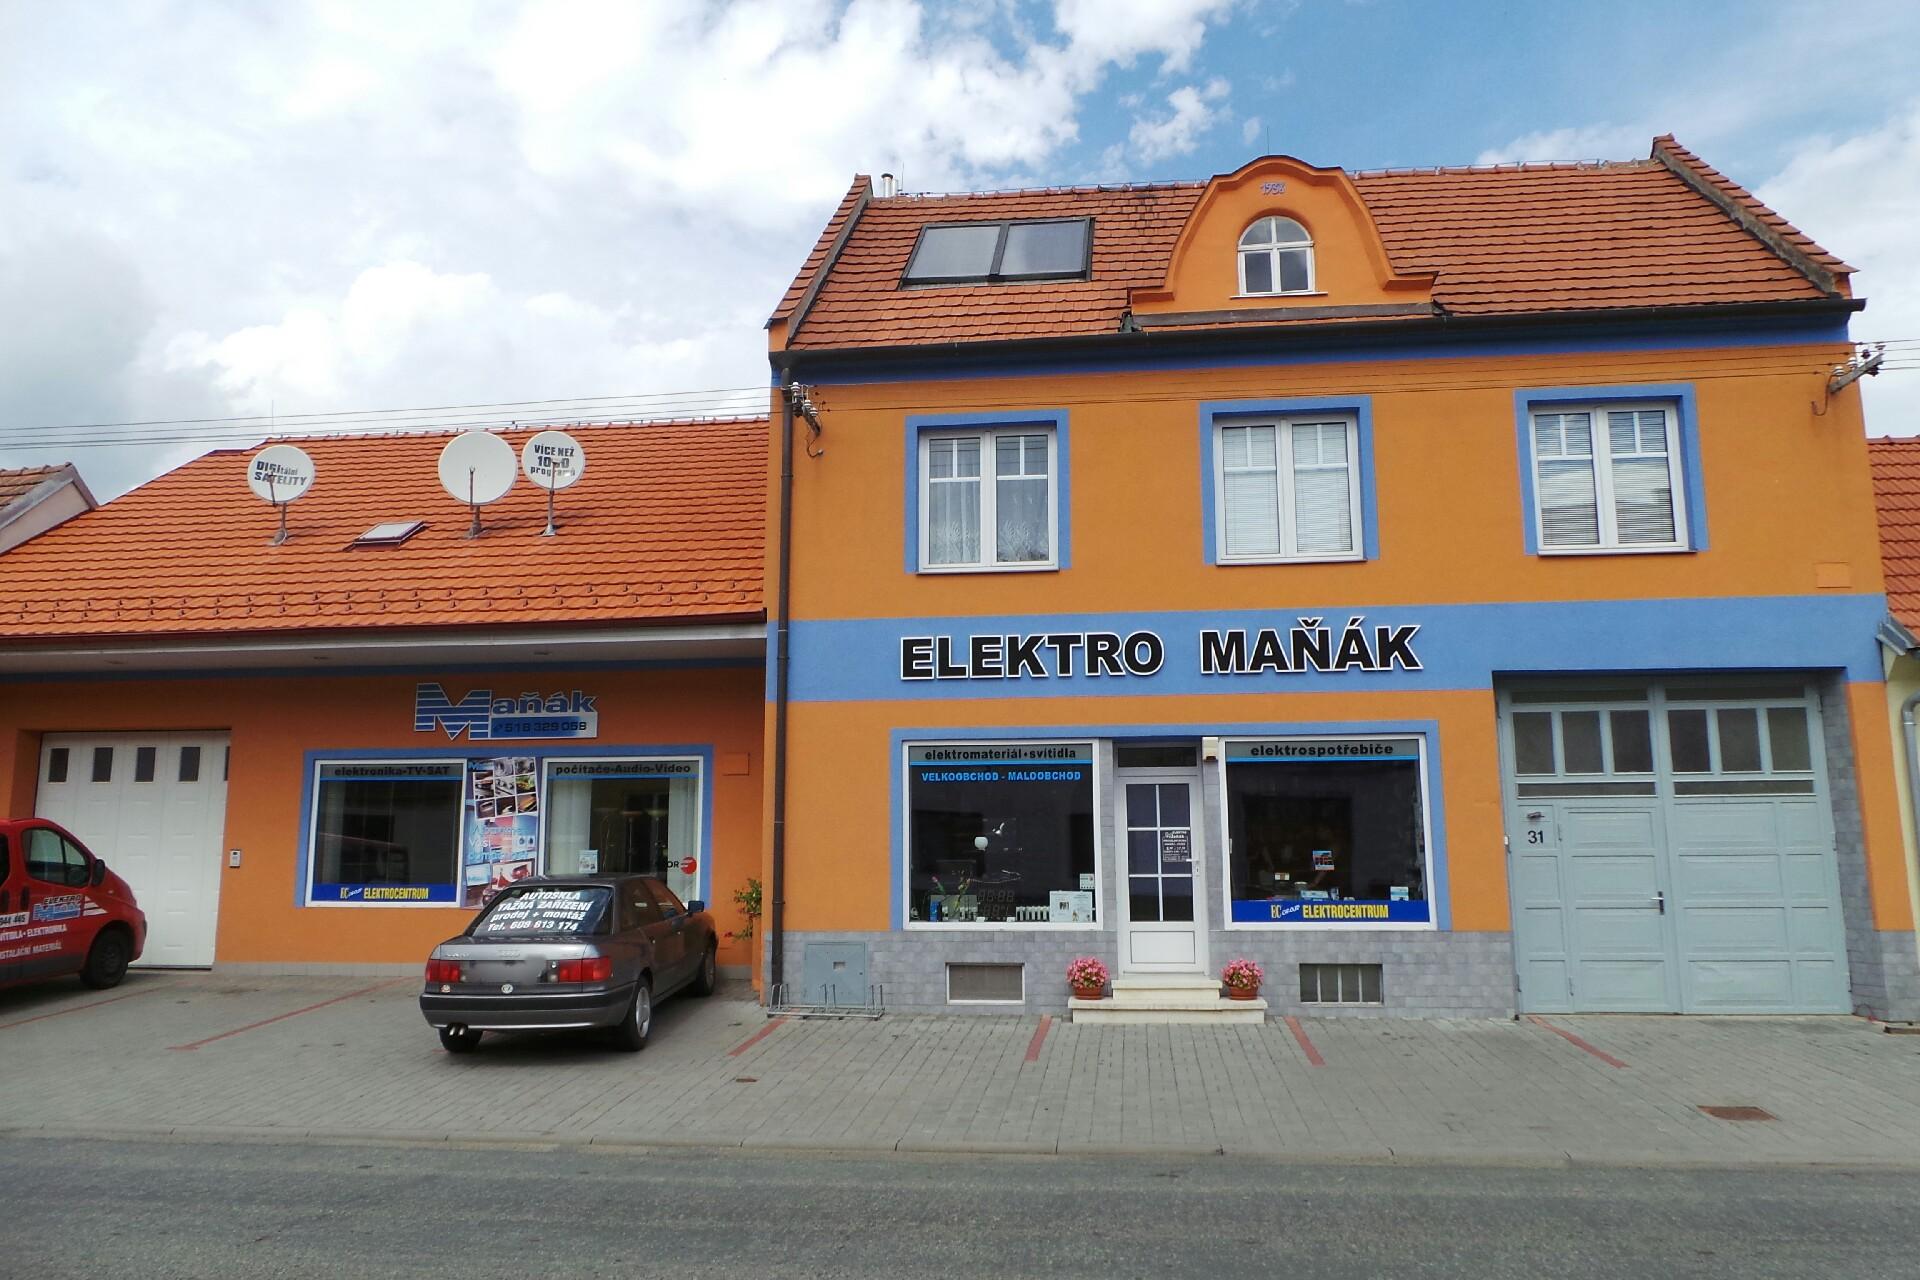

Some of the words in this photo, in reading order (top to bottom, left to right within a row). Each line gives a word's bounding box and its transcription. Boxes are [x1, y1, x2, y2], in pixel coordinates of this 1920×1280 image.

[534, 444, 556, 455] VÍCE
[558, 446, 575, 457] NEŽ
[538, 456, 570, 468] 100
[901, 632, 1164, 680] ELEKTRO
[1199, 616, 1424, 674] MAŇÁK
[414, 683, 599, 740] Maňák
[1250, 744, 1394, 757] elektrospotřebiče
[921, 772, 999, 782] VELKOOBCHOD
[1008, 771, 1081, 781] MALOOBCHOD
[1527, 830, 1544, 844] 31
[363, 887, 429, 899] ELEKTROCENTRUM
[520, 891, 581, 900] AUTOSKLA
[498, 900, 536, 911] TAŽNÁ
[536, 899, 595, 912] ZAŘÍZENÍ
[1302, 904, 1389, 919] ELEKTROCENTRUM
[490, 910, 529, 922] prodej
[543, 911, 586, 920] montáž
